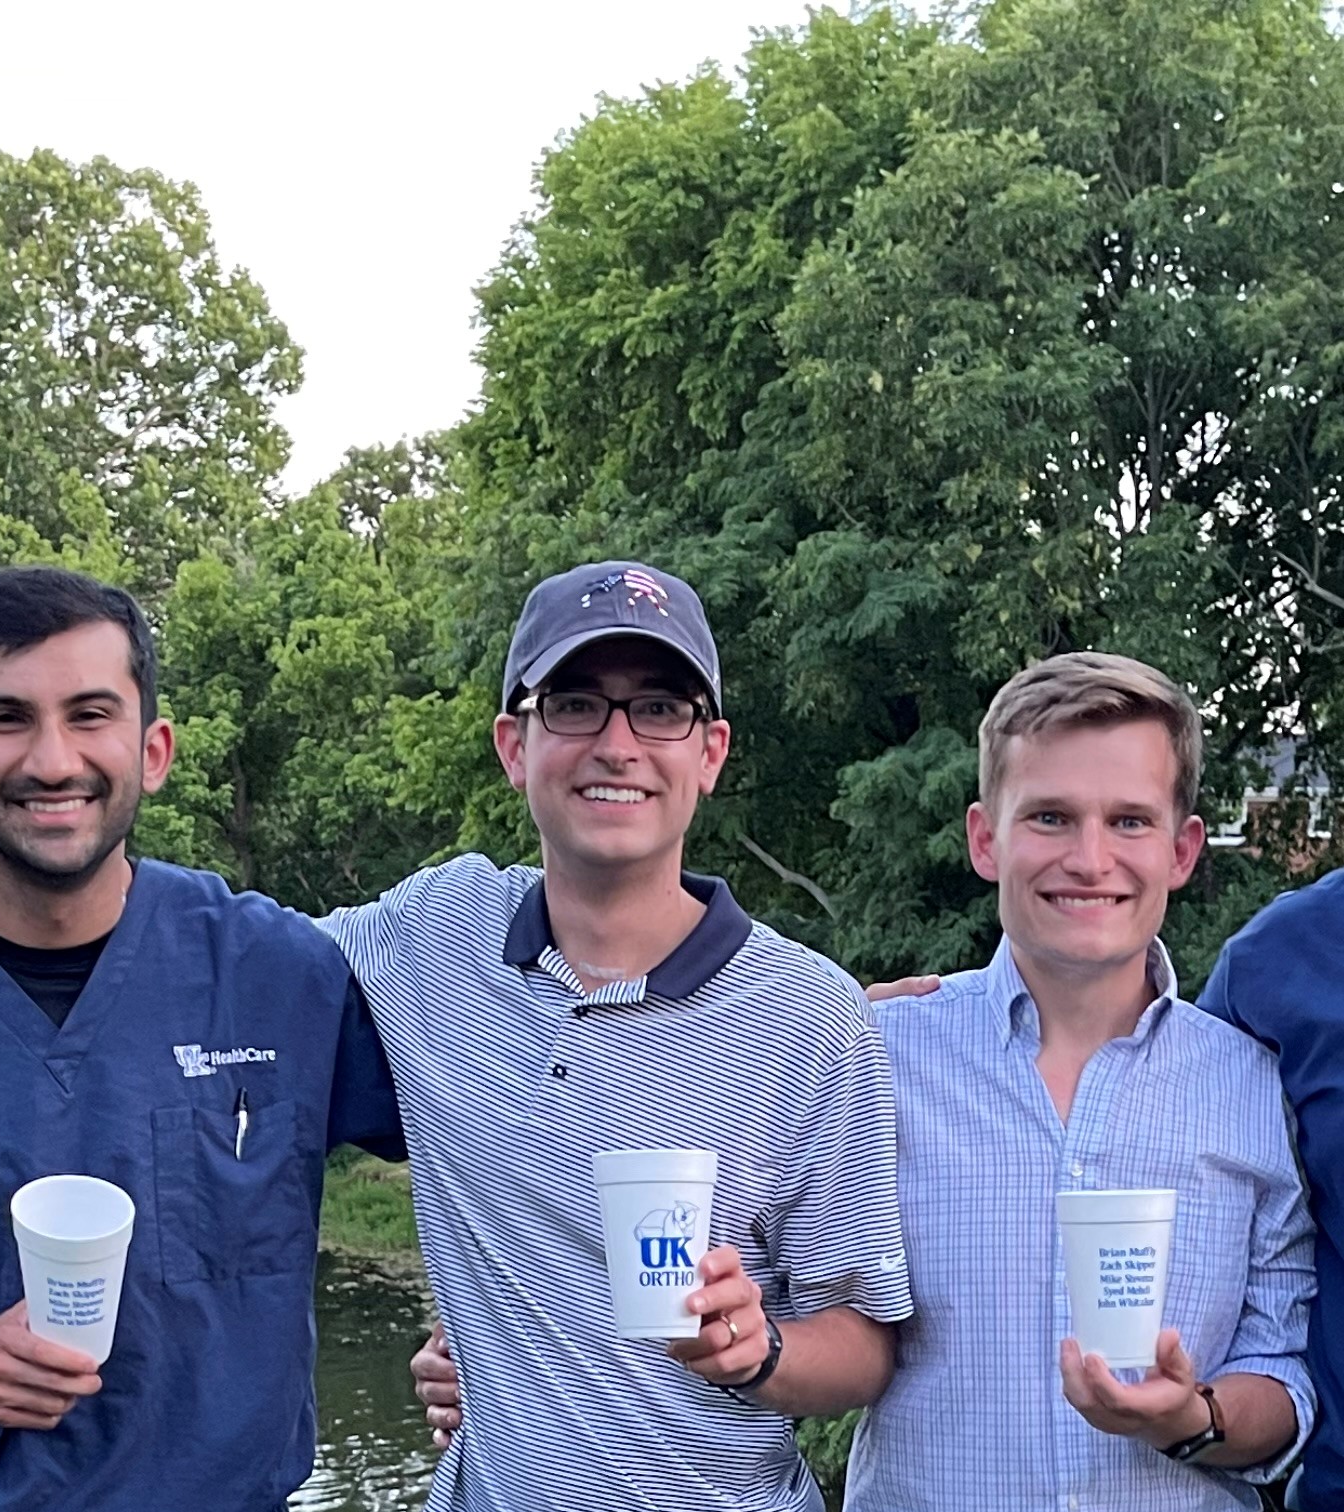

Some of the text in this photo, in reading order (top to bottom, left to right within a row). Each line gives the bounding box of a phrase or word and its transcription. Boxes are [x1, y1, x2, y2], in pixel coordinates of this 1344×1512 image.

[211, 1047, 276, 1066] HealthCare
[640, 1236, 694, 1269] UK
[1100, 1260, 1122, 1271] Zach
[639, 1271, 695, 1287] ORTHO
